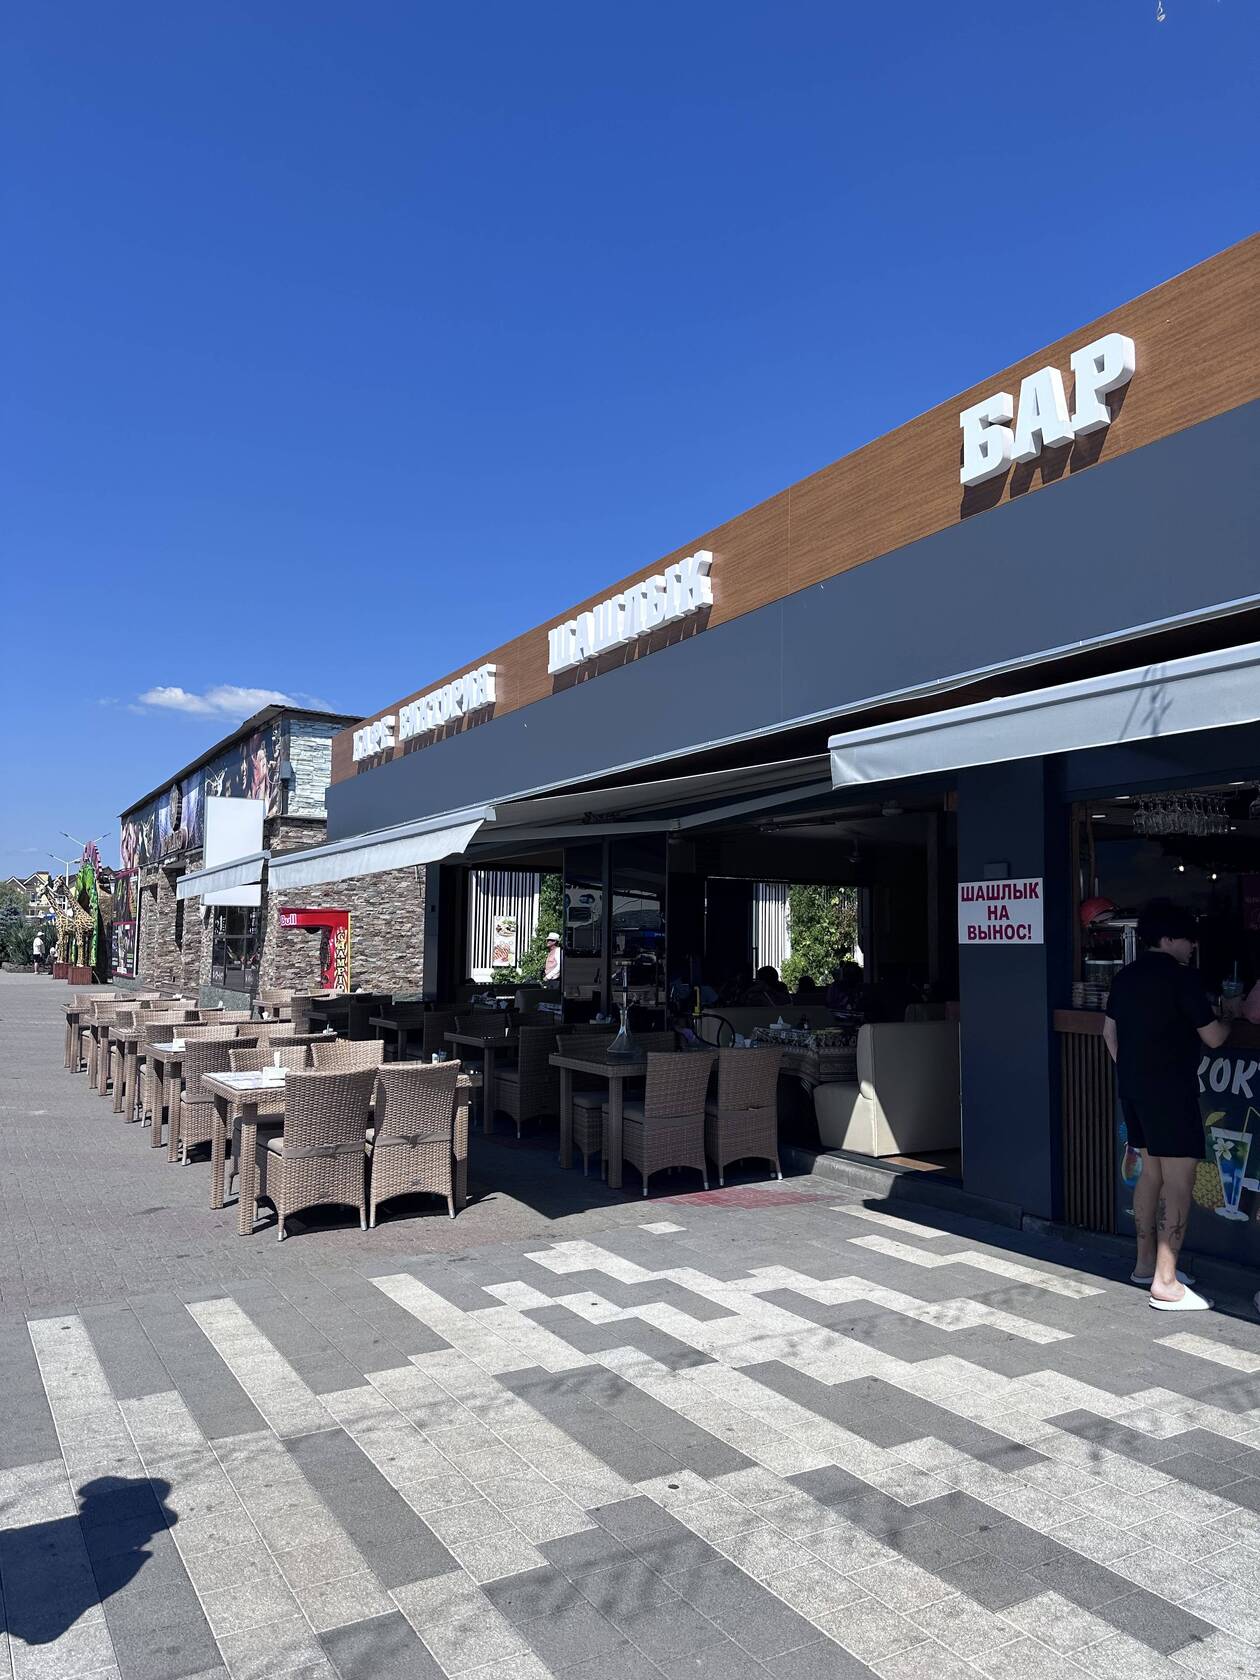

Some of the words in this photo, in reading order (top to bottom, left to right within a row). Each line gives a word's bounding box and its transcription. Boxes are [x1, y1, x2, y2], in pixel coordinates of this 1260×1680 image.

[959, 332, 1136, 487] БАР
[548, 550, 714, 675] ШАШЛЫК
[398, 663, 497, 741] ВИКТОРИЯ
[961, 882, 1039, 902] ШАШЛЫК
[987, 905, 1010, 920] НА
[967, 924, 1032, 940] ВЫНОС!
